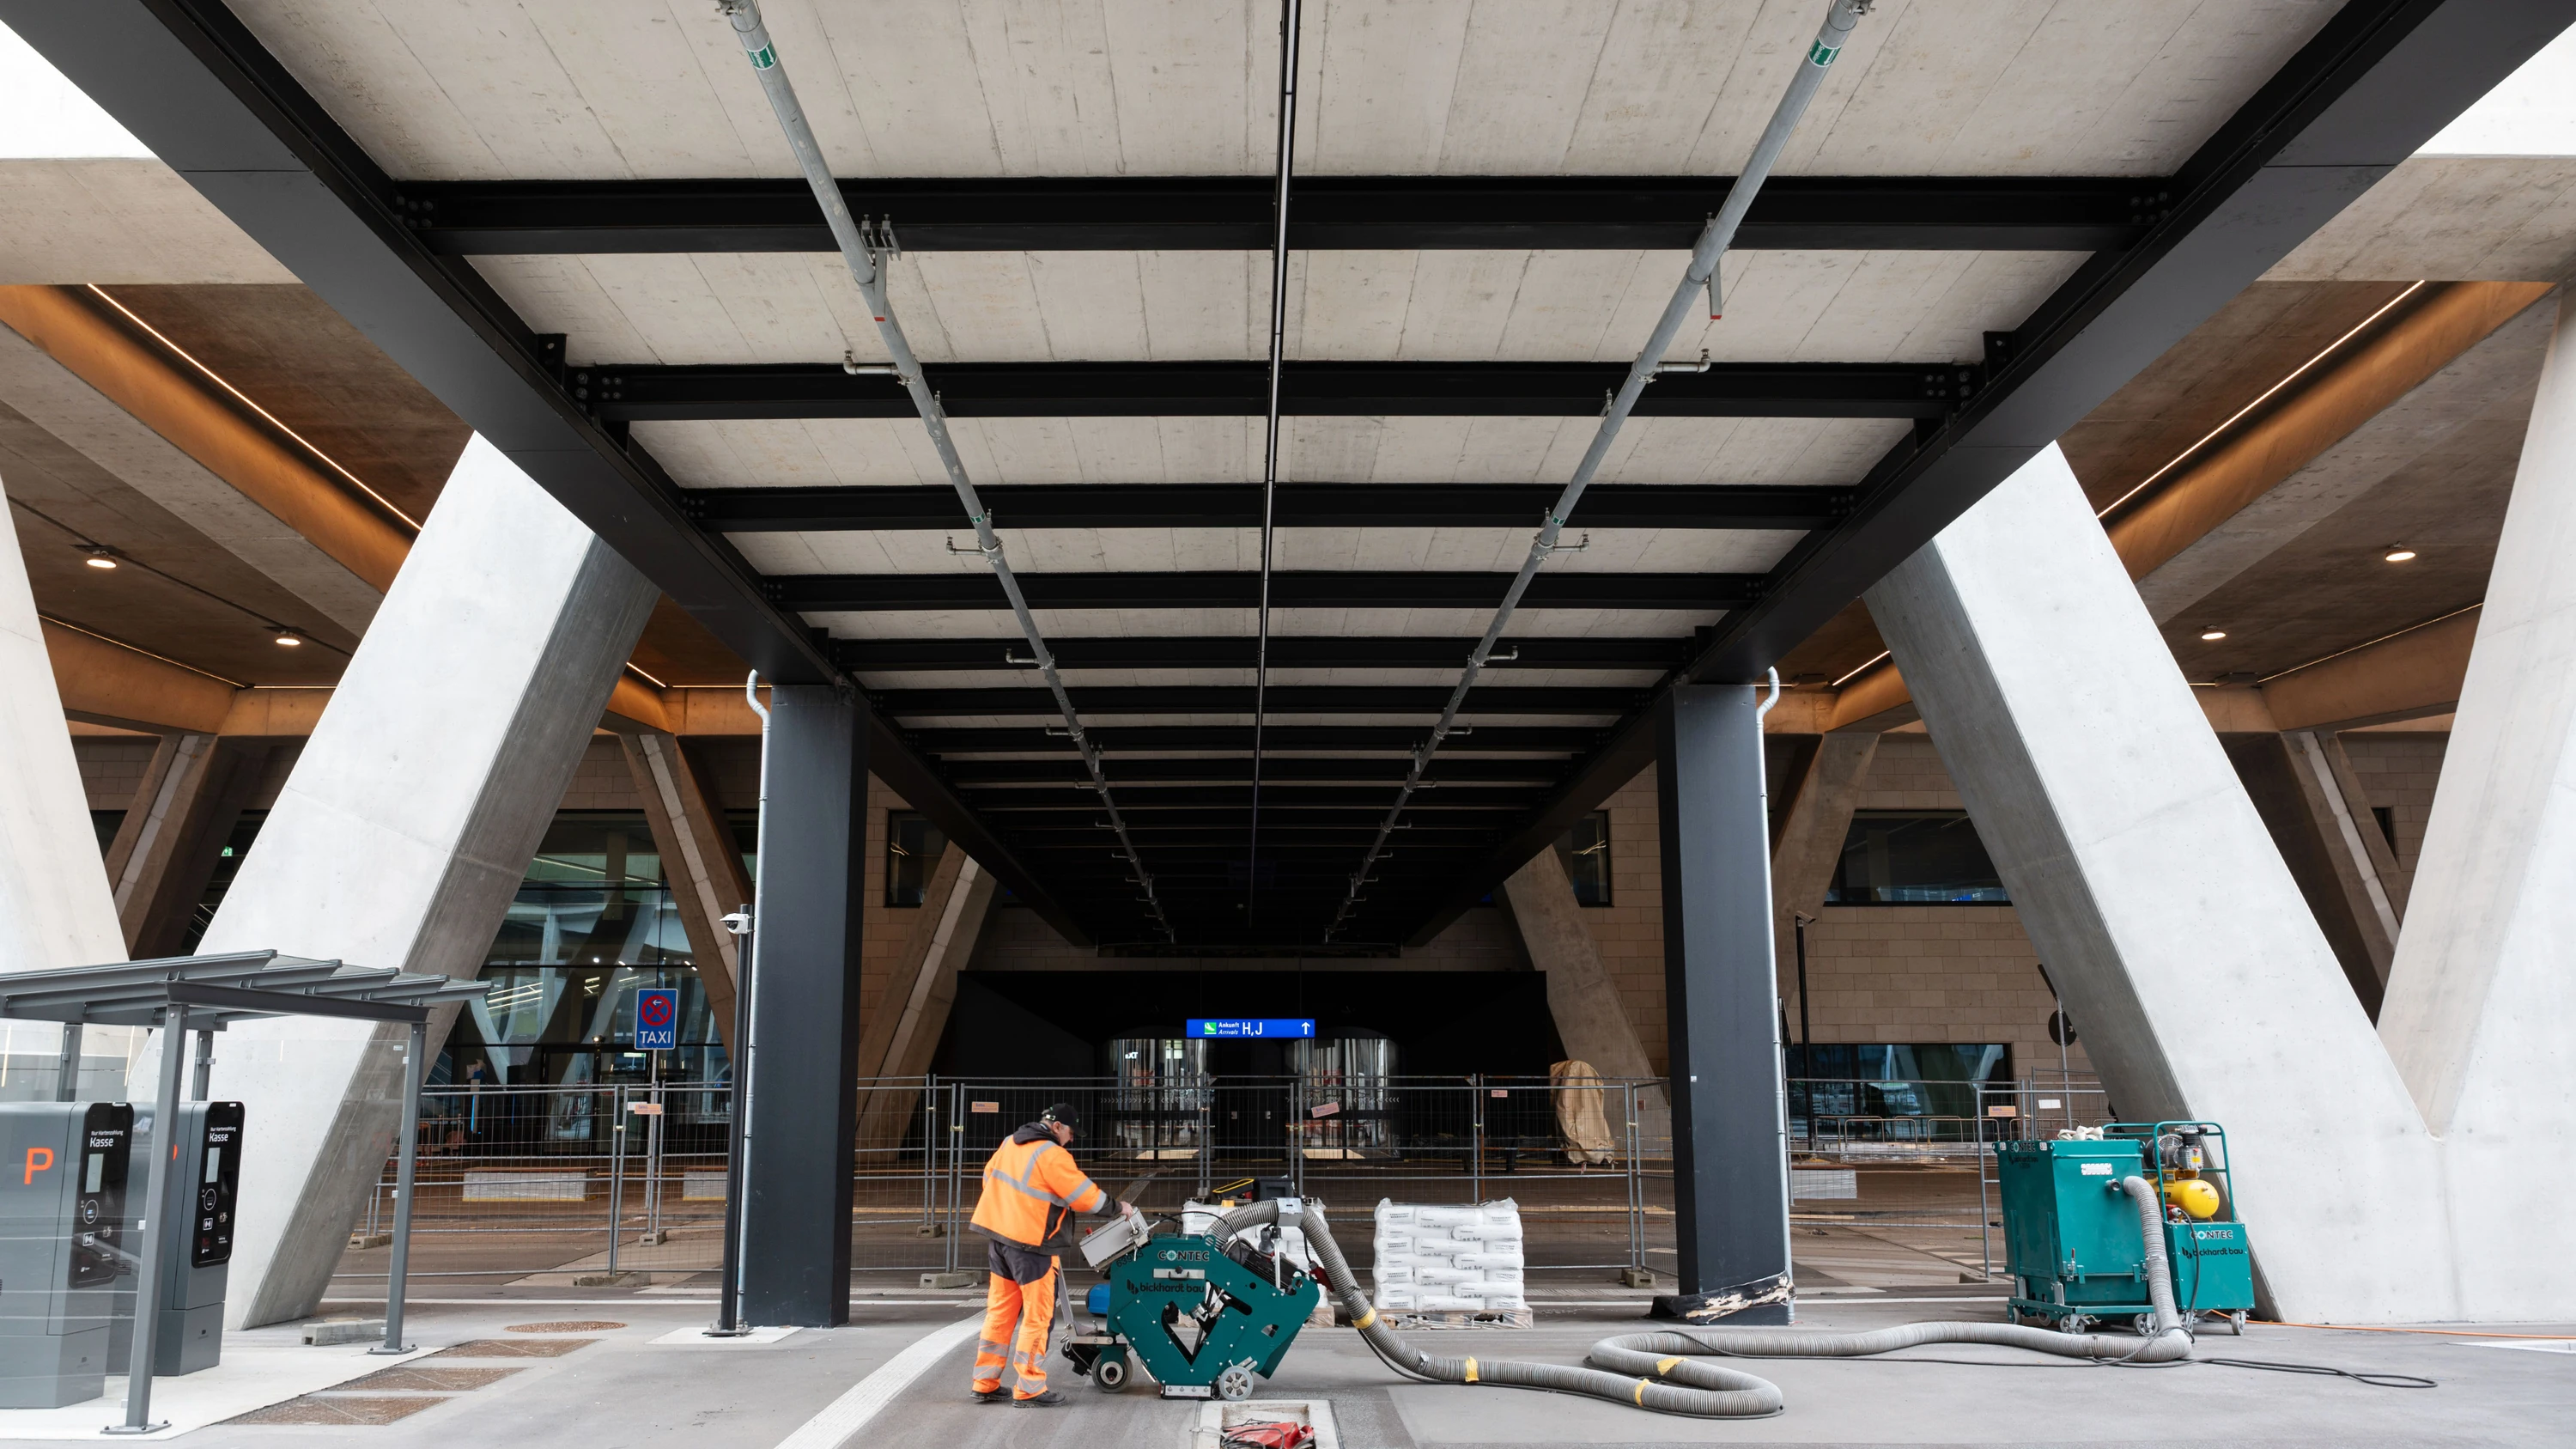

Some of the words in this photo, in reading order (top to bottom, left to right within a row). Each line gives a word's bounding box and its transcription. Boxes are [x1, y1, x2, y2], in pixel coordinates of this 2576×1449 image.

[1242, 1022, 1262, 1036] H,J
[640, 1031, 671, 1044] TAXI
[89, 1137, 113, 1148] Kasse
[209, 1132, 228, 1142] Kasse
[2009, 1142, 2036, 1154] CONTEC
[24, 1147, 54, 1185] P
[1157, 1250, 1210, 1262] CONTEC
[2192, 1247, 2227, 1256] bckhardt
[1115, 1250, 1144, 1268] 6393
[1139, 1282, 1184, 1293] bickhardt
[1187, 1282, 1205, 1293] bau
